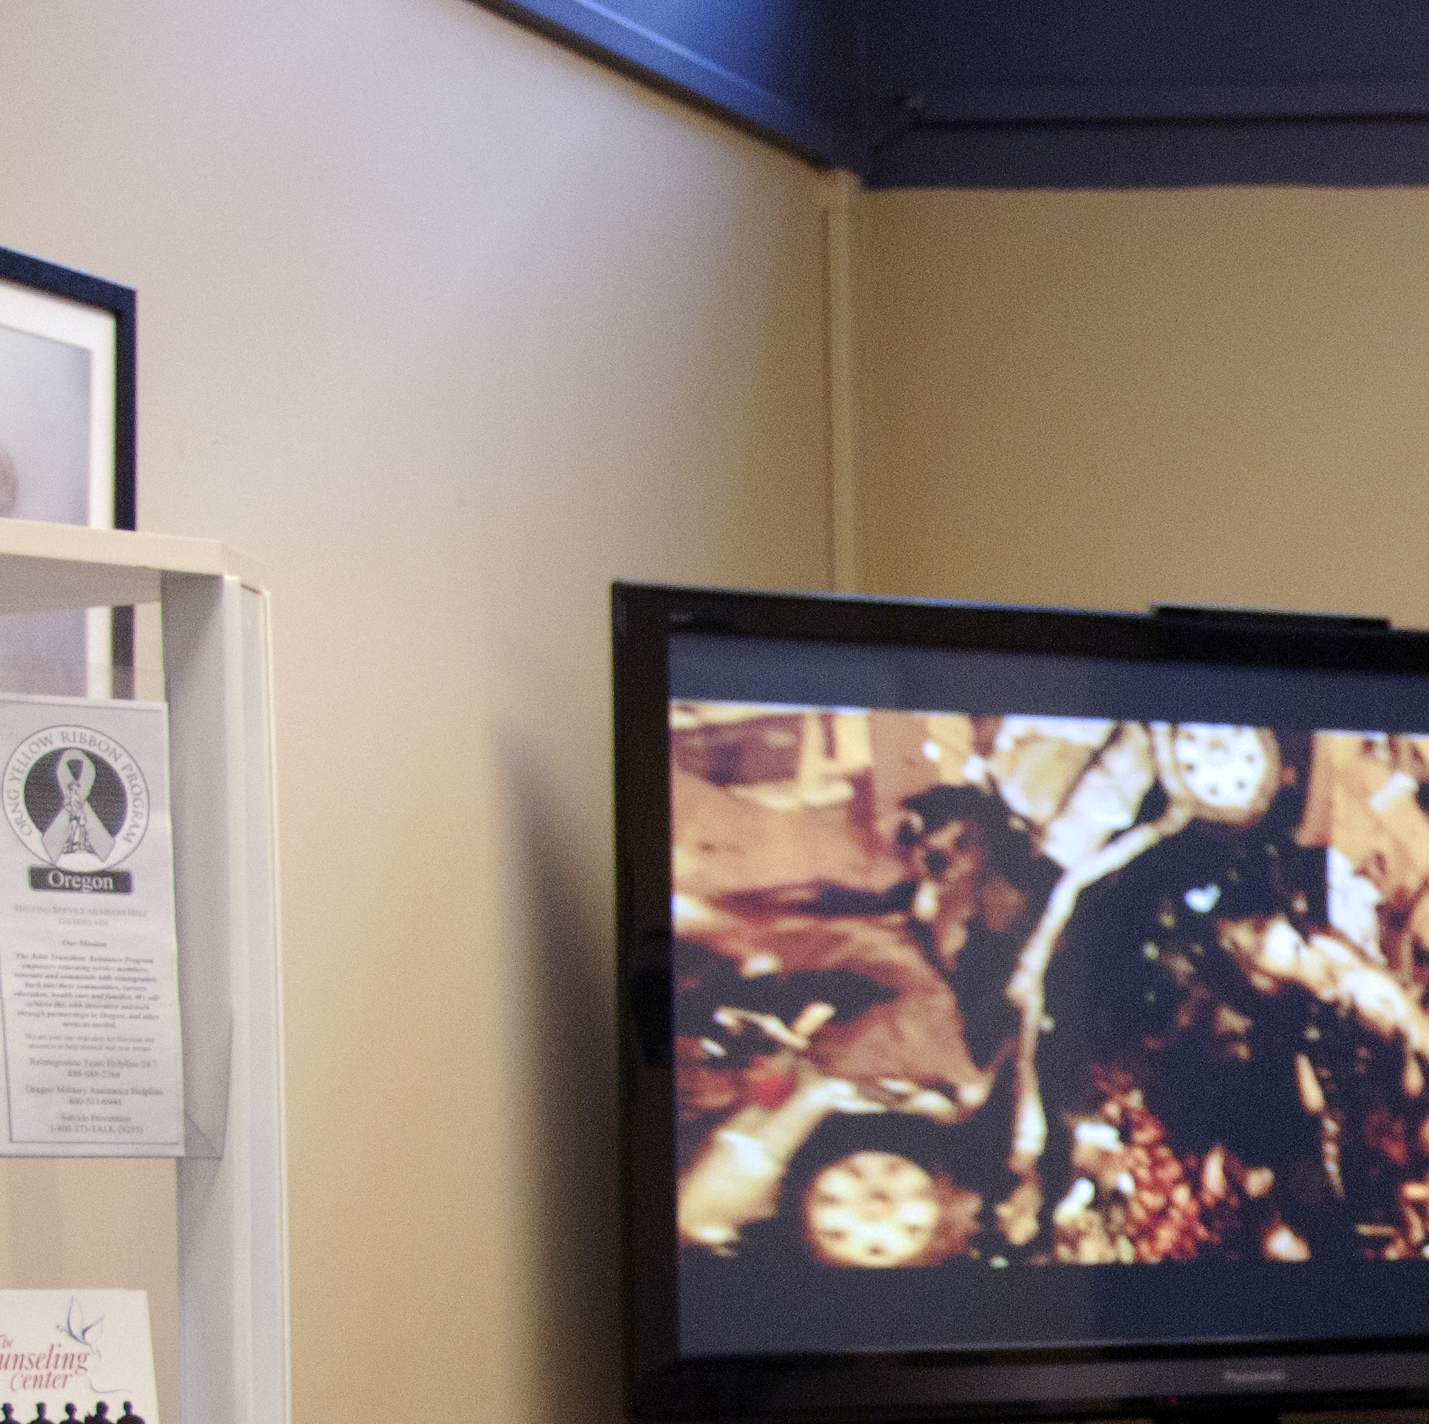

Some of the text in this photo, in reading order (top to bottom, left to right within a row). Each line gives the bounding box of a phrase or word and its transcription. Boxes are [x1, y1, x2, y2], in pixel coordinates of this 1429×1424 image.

[8, 731, 145, 844] ORNG YELLOW RIBBON PROGRAM
[48, 871, 114, 892] Oregon
[0, 1343, 90, 1375] unseling
[10, 1371, 73, 1392] Center
